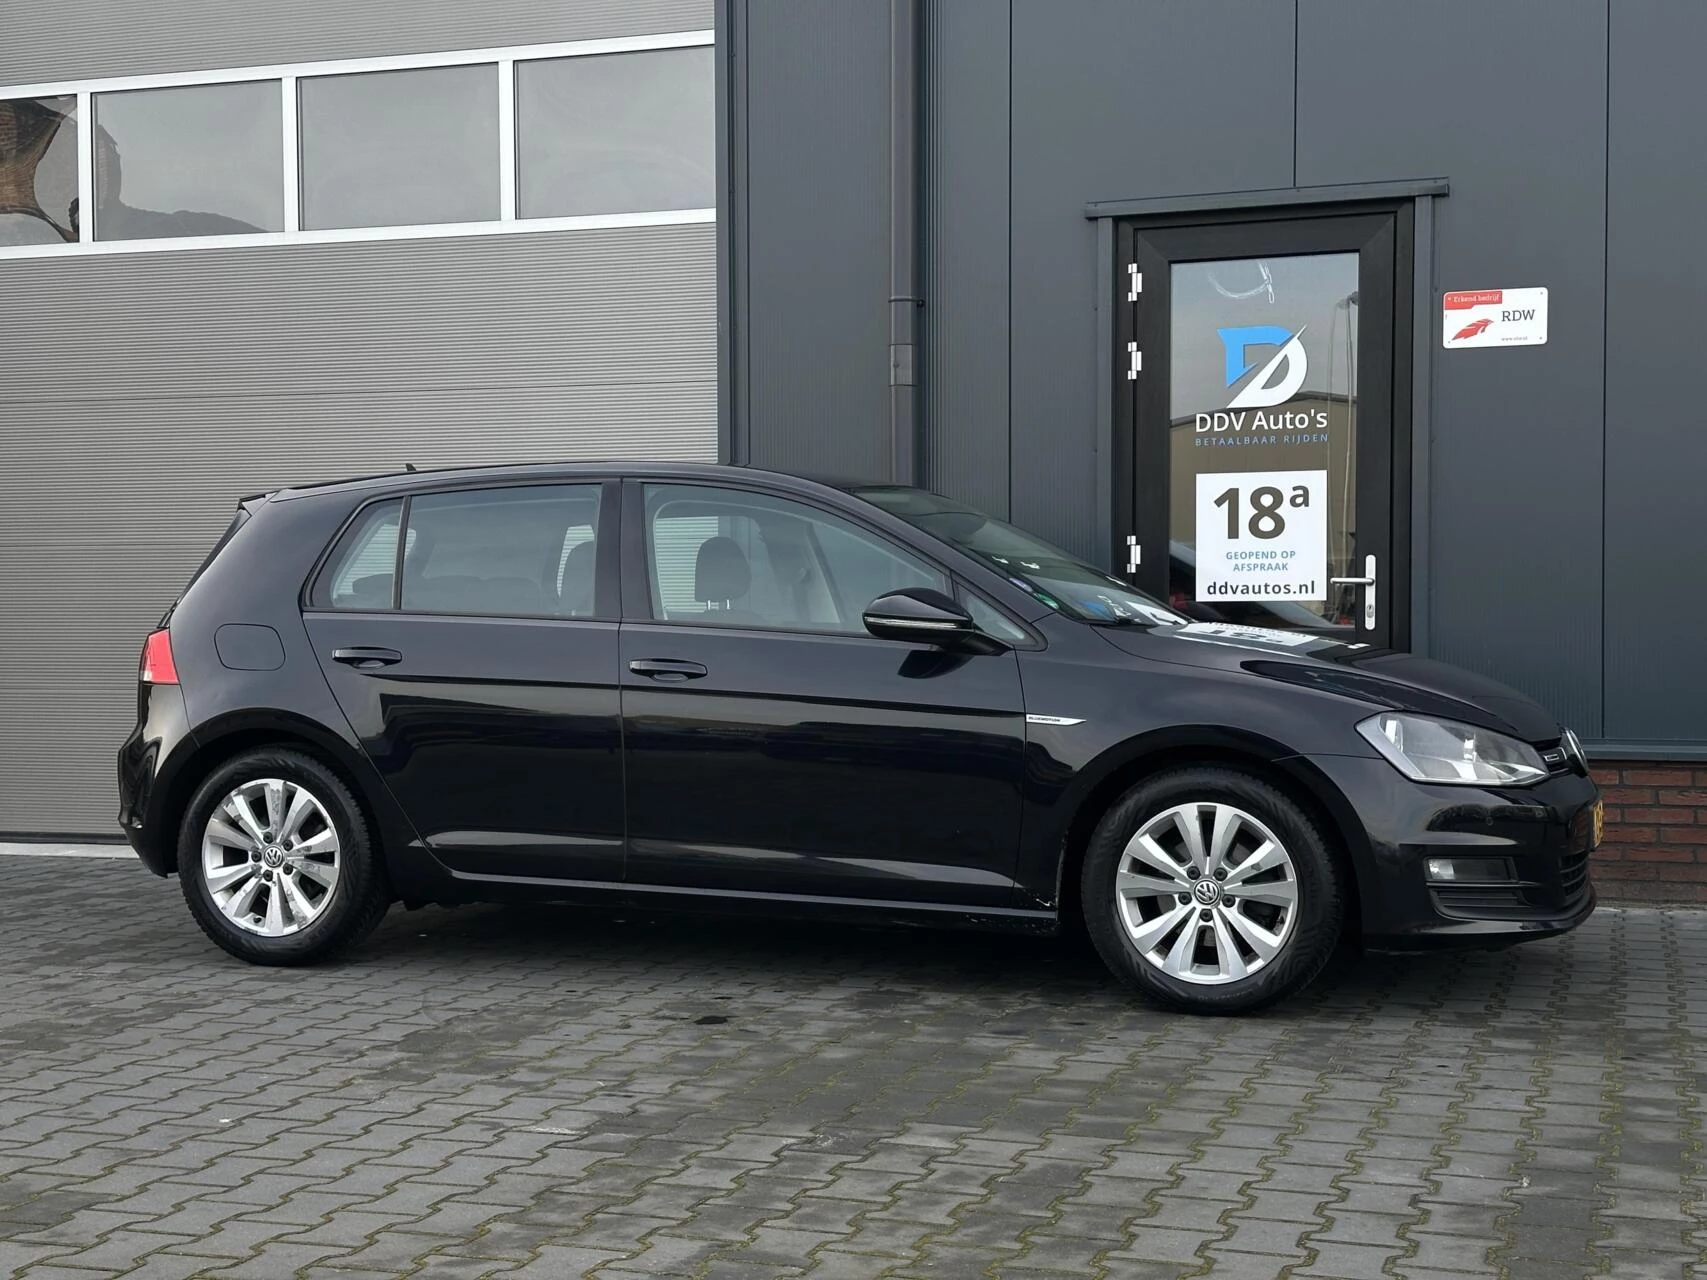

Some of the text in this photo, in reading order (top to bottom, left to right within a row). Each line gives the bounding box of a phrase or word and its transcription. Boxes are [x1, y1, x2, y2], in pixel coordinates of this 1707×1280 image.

[1453, 293, 1500, 303] Erkend bedrijf
[1501, 309, 1535, 322] RDW
[1195, 408, 1328, 433] DDV Auto's
[1195, 433, 1328, 447] BETAALBAAR RIJDEN
[1225, 550, 1297, 560] GEOPEND OP
[1233, 562, 1289, 572] AFSPRAAK
[1206, 580, 1315, 595] ddvautos.nl
